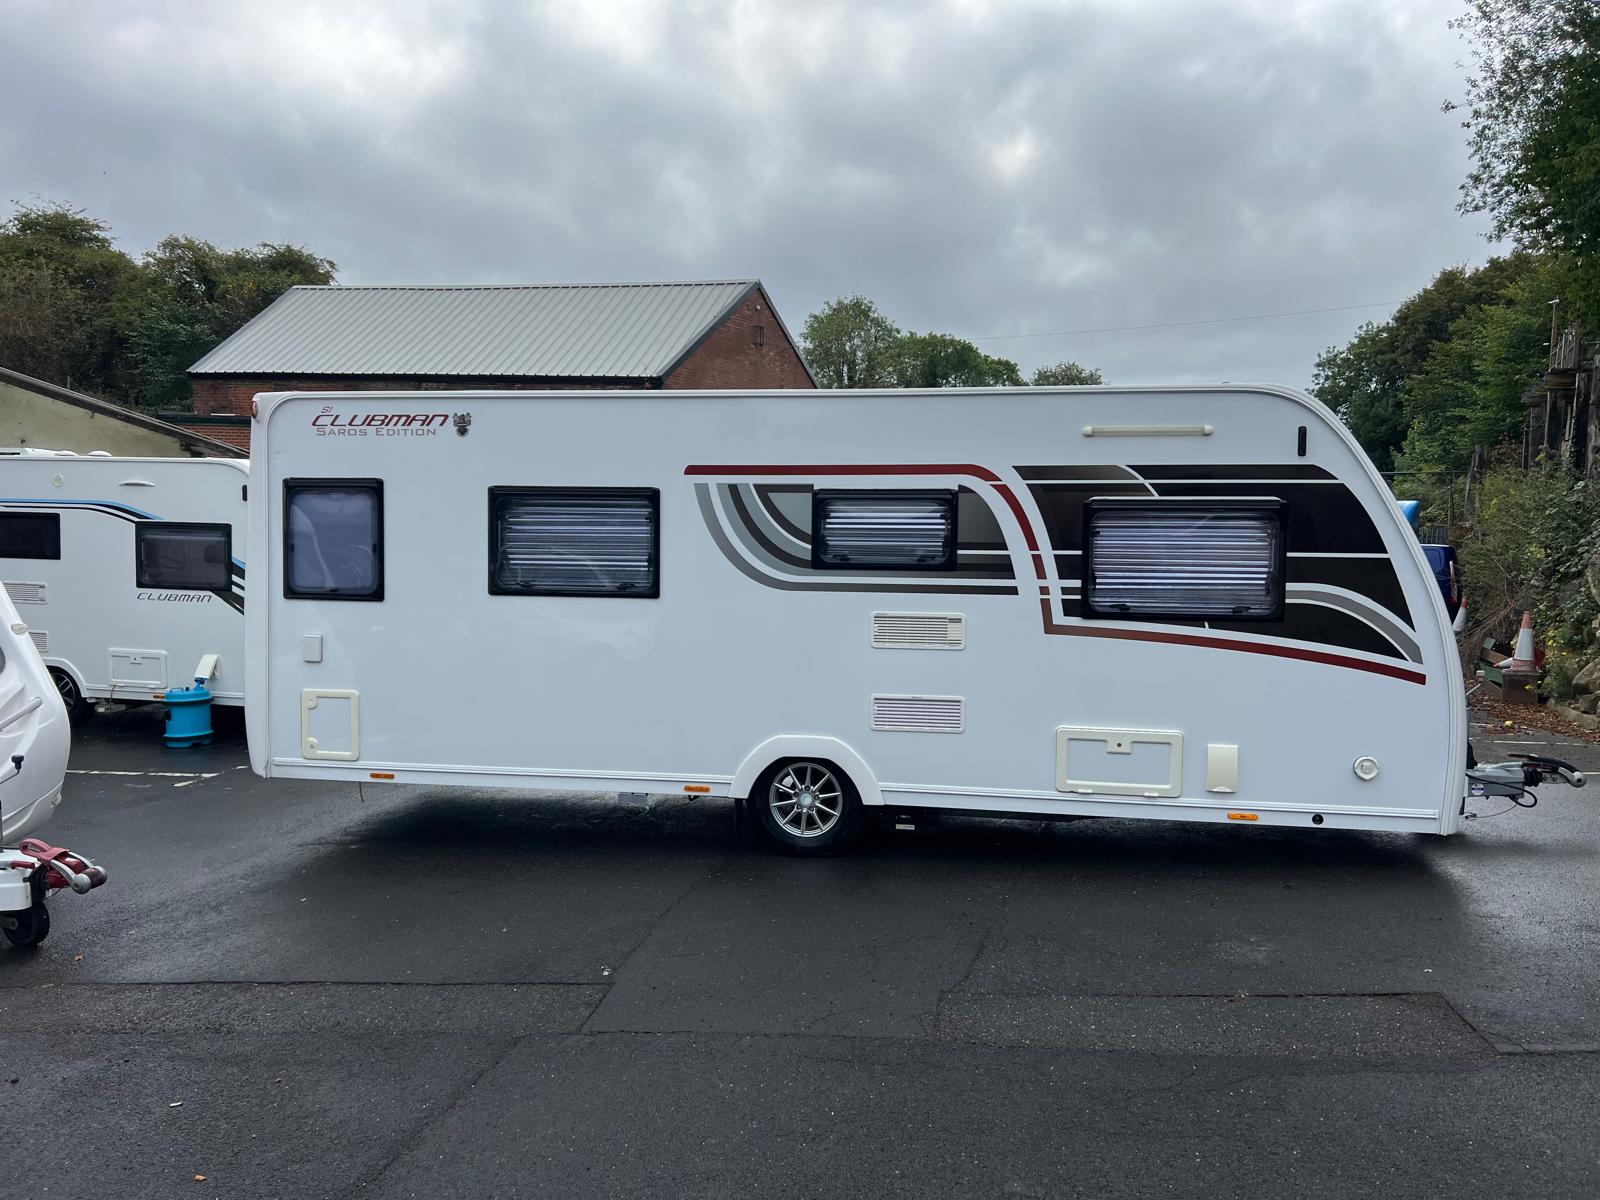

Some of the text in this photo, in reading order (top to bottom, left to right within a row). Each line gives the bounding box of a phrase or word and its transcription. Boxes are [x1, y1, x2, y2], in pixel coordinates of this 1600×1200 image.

[311, 414, 449, 427] CLUBMAN
[316, 427, 436, 436] SAROS EDITION
[137, 592, 212, 603] CLUBMAN
